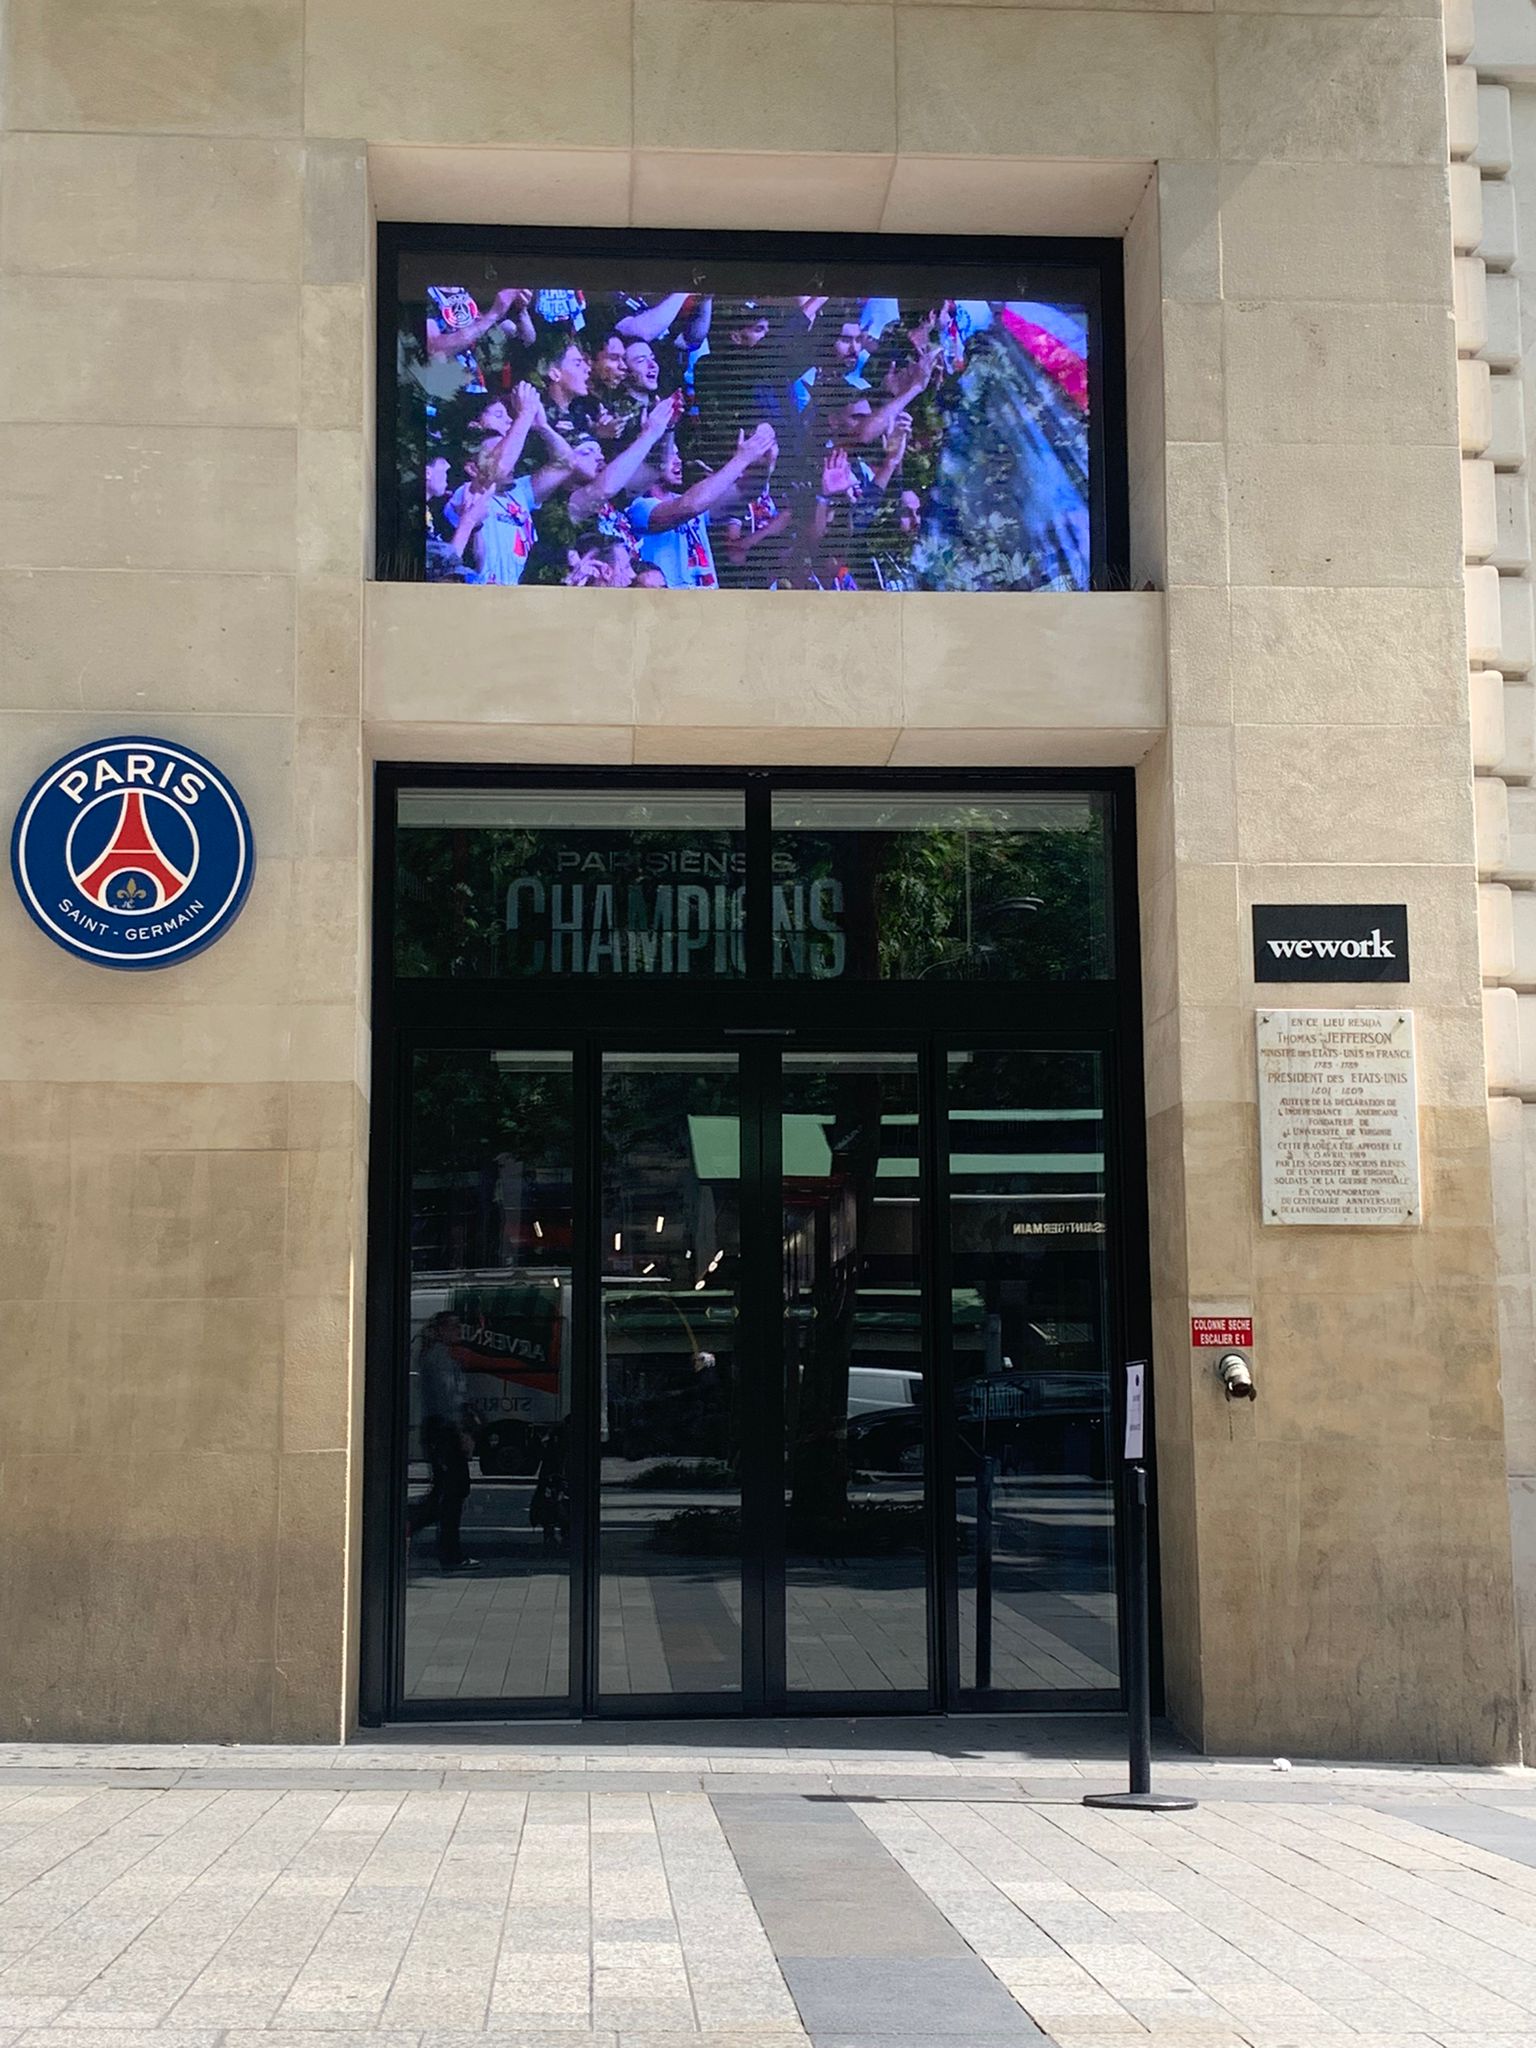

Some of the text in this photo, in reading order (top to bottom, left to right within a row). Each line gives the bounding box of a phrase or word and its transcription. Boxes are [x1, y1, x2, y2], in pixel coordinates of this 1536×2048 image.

[58, 754, 206, 805] PARIS
[58, 898, 110, 936] SAINT
[124, 899, 204, 941] GERMAIN
[1266, 928, 1396, 959] wework
[1291, 1018, 1302, 1027] EN
[1306, 1018, 1317, 1027] CE
[1323, 1018, 1345, 1027] LIEU
[1325, 1032, 1393, 1044] JEFFERSON
[1261, 1049, 1296, 1058] MINISTRE
[1377, 1049, 1412, 1058] FRANCE
[1312, 1098, 1321, 1106] DE
[1323, 1098, 1332, 1106] LA
[1387, 1098, 1397, 1106] DE
[1308, 1118, 1369, 1126] FONDATEUR DE
[1346, 1129, 1356, 1137] DE
[1278, 1142, 1301, 1150] CETTE
[1393, 1142, 1402, 1150] LE
[1293, 1197, 1339, 1205] CENTENAIRE
[1346, 1197, 1401, 1205] ANNIVERSAIRE
[1194, 1319, 1226, 1331] COLONNE
[1200, 1333, 1233, 1345] ESCALIER
